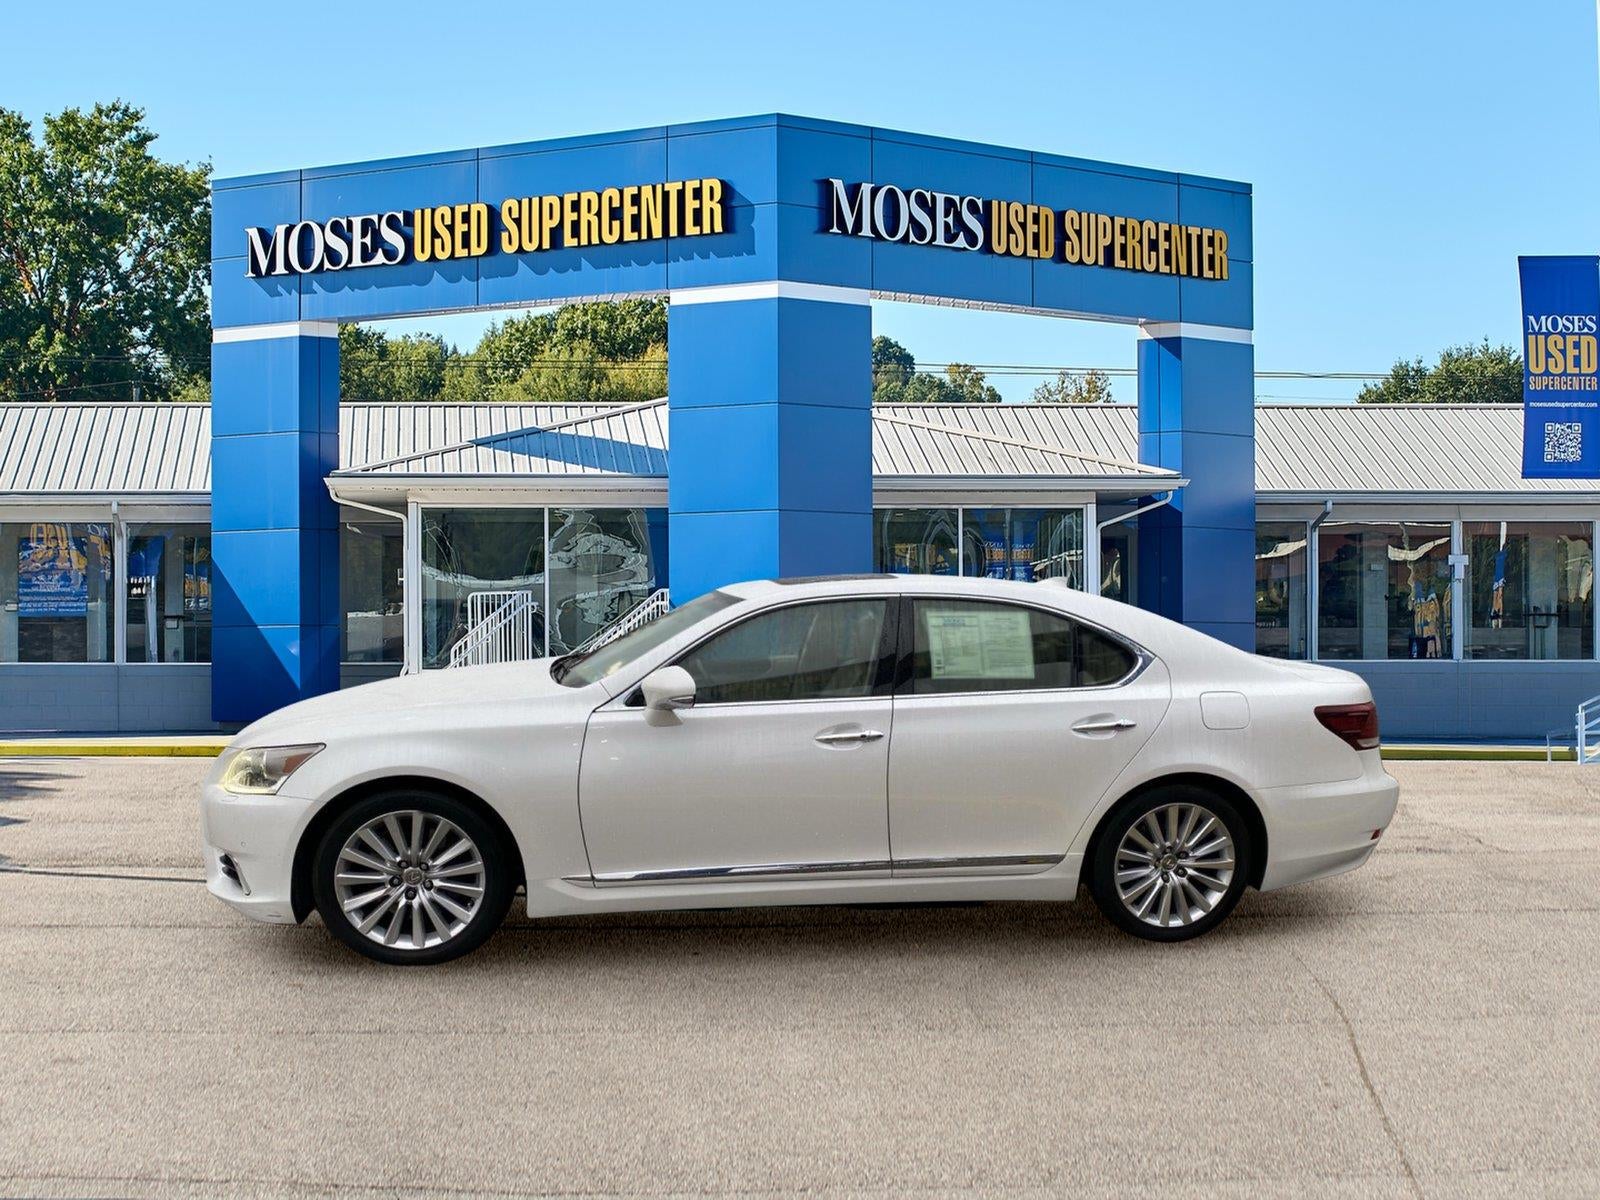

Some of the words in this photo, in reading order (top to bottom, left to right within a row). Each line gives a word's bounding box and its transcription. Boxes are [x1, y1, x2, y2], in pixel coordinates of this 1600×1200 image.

[245, 212, 406, 278] MOSES
[413, 203, 490, 263] USED
[501, 178, 723, 254] SUPERCENTER
[829, 178, 984, 251] MOSES
[991, 200, 1056, 260] USED
[1065, 209, 1229, 280] SUPERCENTER
[1528, 315, 1597, 333] MOSES
[1528, 335, 1598, 375] USED
[1529, 376, 1598, 391] SUPERCENTER
